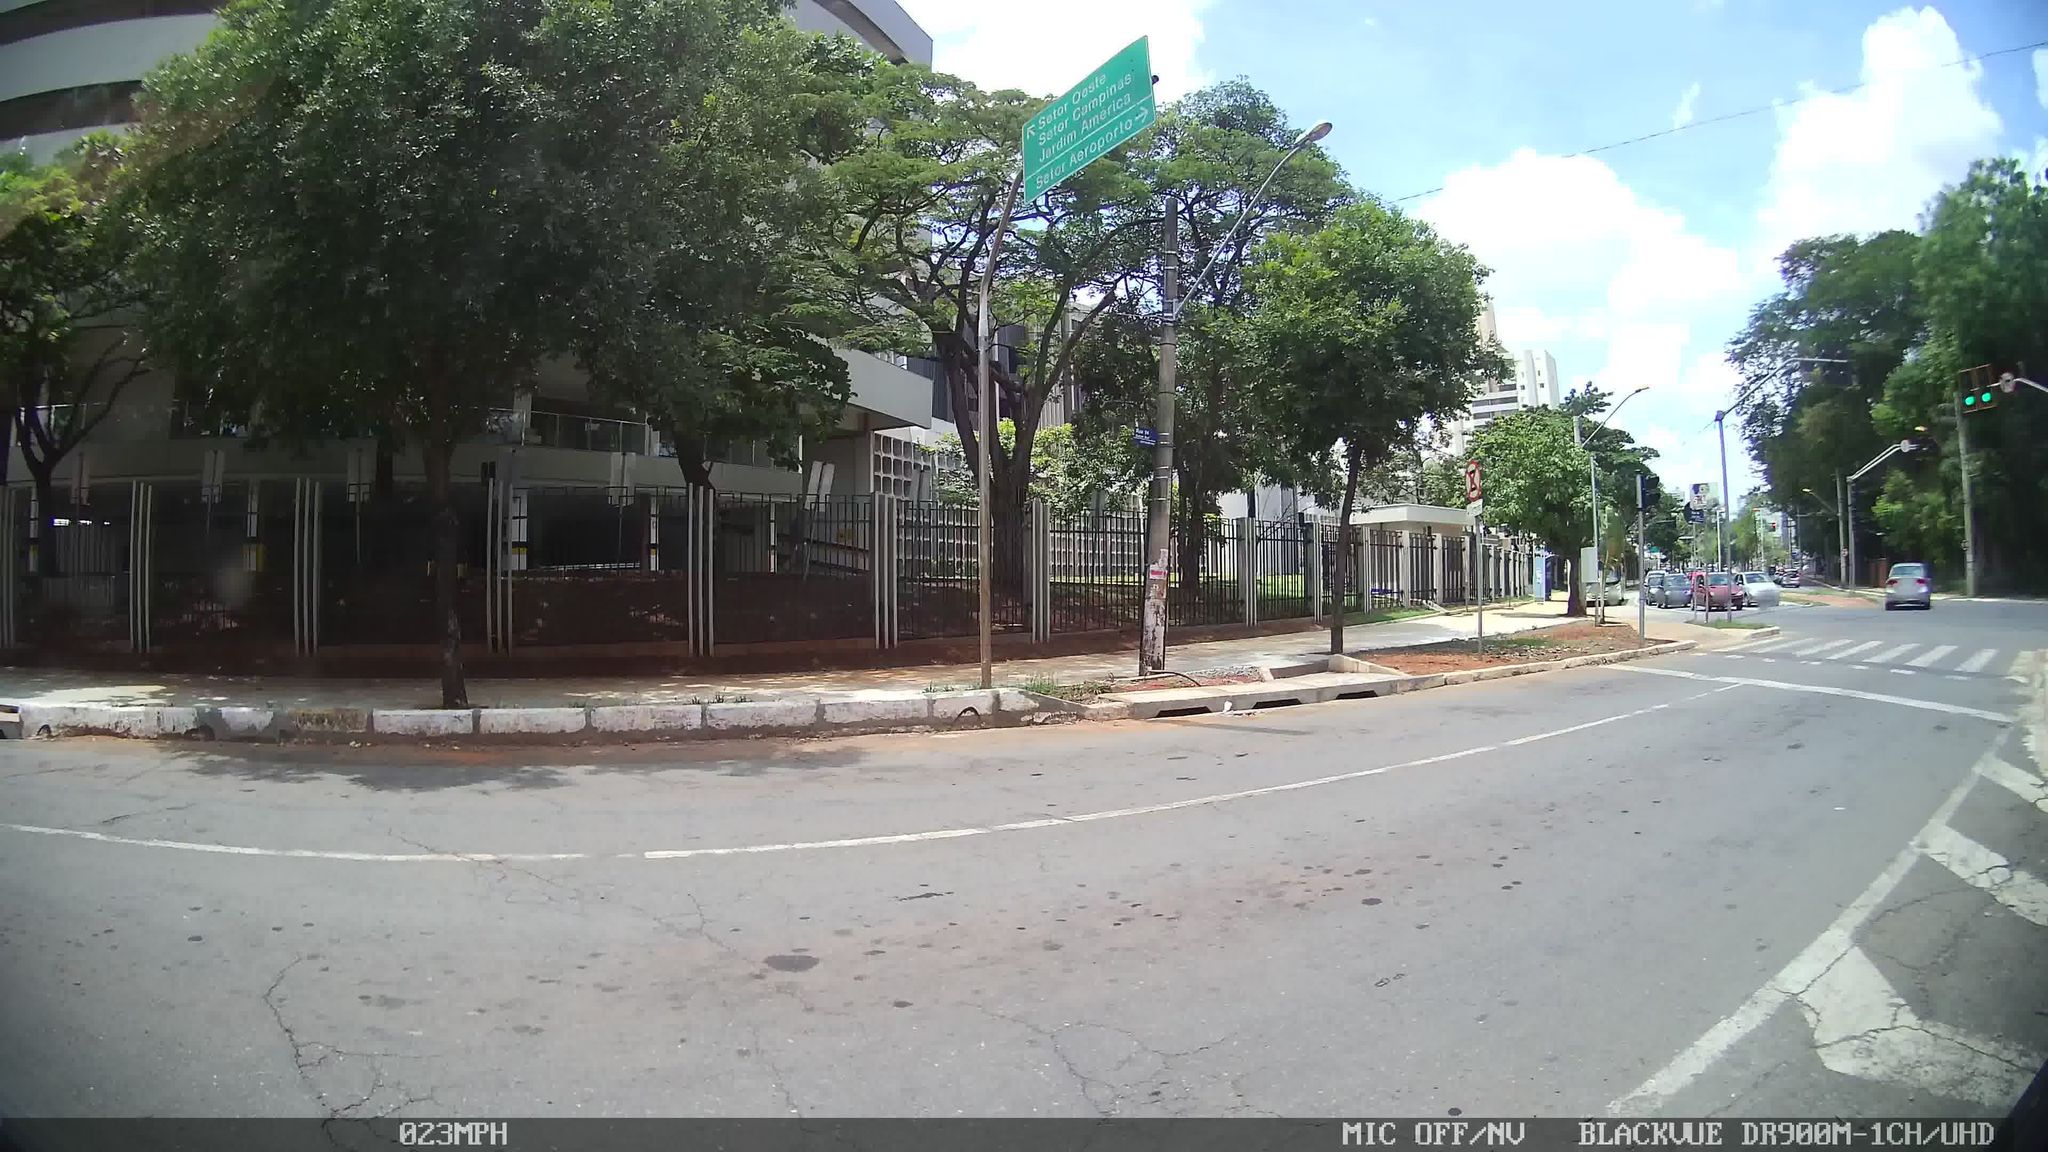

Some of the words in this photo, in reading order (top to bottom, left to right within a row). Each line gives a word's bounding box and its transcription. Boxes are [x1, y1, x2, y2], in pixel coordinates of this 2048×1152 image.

[1038, 119, 1070, 146] Setor
[1072, 73, 1132, 122] Campinas
[1038, 103, 1068, 130] Setor
[1036, 164, 1066, 190] Setor
[1069, 118, 1133, 168] Aeroporto
[1039, 130, 1077, 163] Jardim
